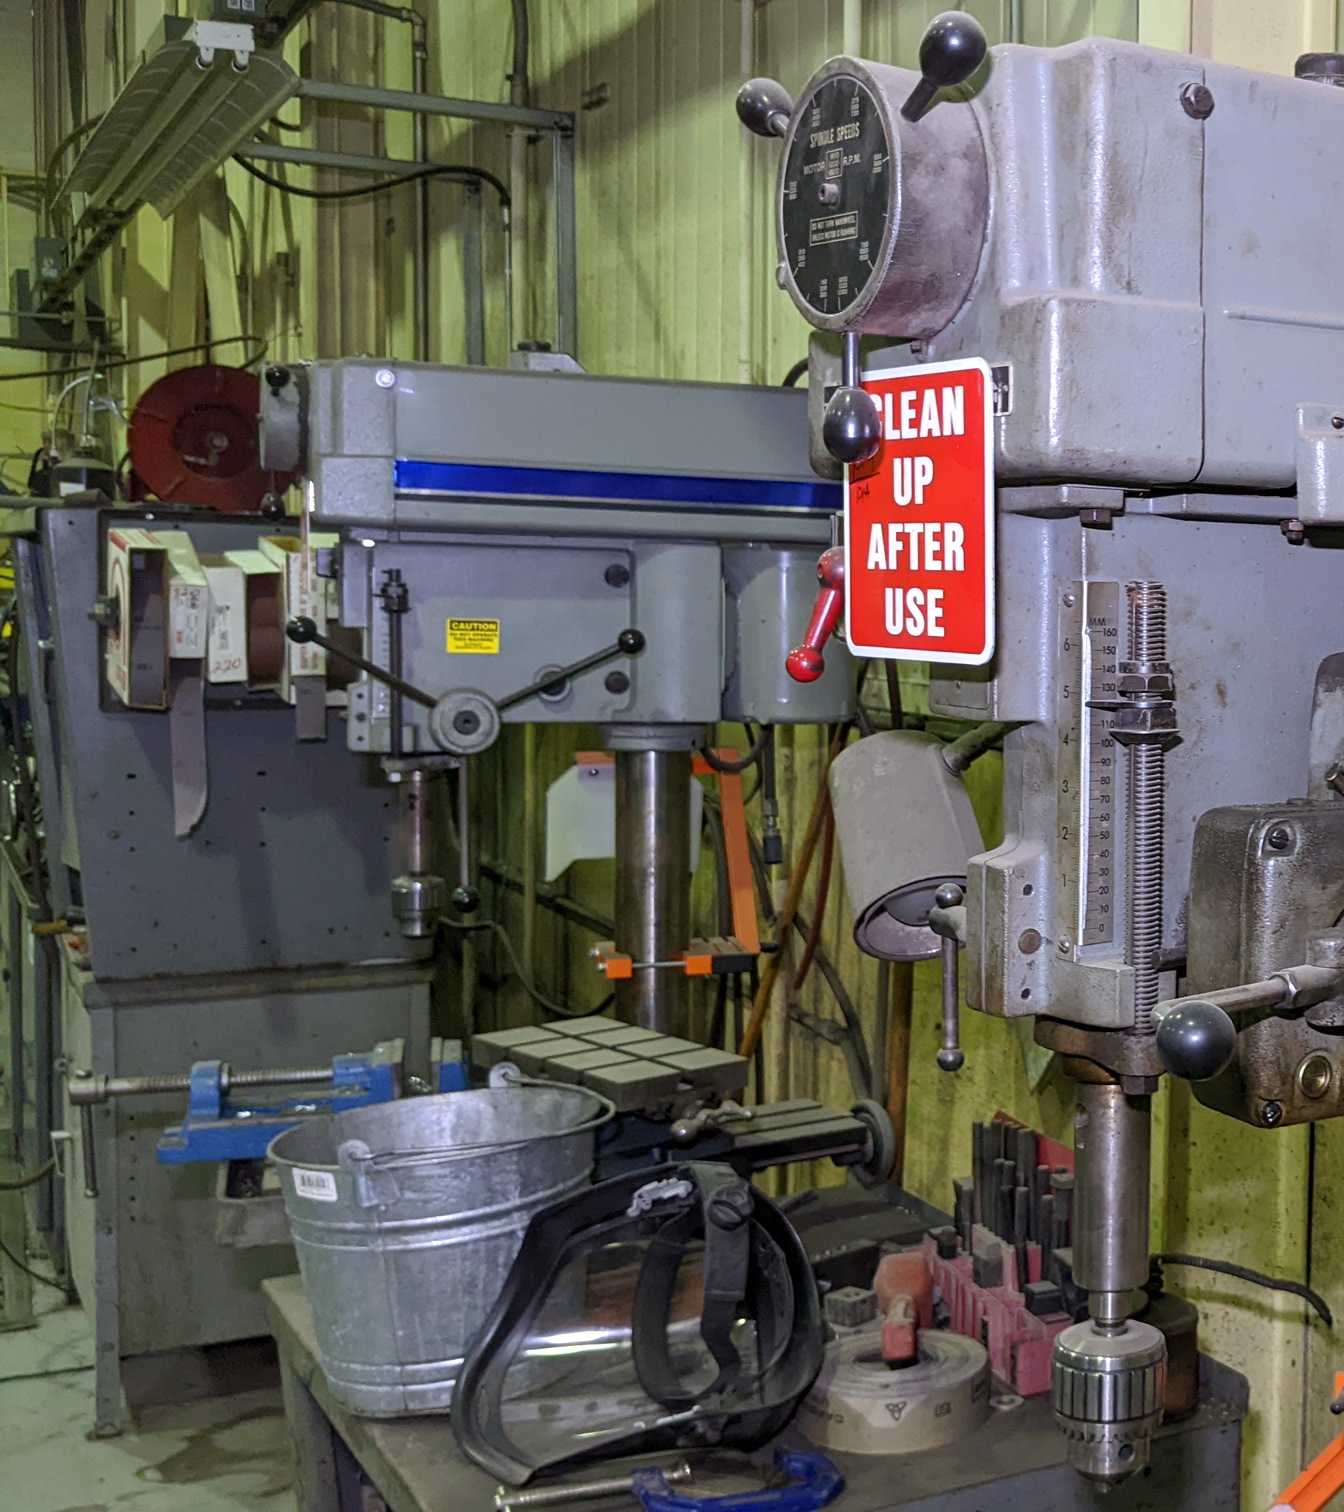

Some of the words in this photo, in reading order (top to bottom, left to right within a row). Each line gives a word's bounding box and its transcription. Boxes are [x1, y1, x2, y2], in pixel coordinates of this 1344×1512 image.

[810, 128, 834, 148] SPINDLE
[836, 121, 860, 142] SPEEDS
[892, 456, 934, 507] UP
[867, 523, 965, 571] AFTER
[885, 588, 945, 637] USE
[451, 622, 497, 631] CAUTION
[1089, 617, 1106, 626] MM
[1103, 628, 1118, 637] 160
[1063, 638, 1071, 652] 6
[1103, 646, 1117, 656] 150
[1102, 664, 1117, 674] 140
[1063, 685, 1071, 699] 5
[1102, 682, 1116, 692] 130
[1101, 719, 1115, 729] 110
[1062, 733, 1069, 746] 4
[1101, 738, 1114, 748] 100
[1100, 758, 1111, 767] 90
[1100, 776, 1111, 785] 80
[1062, 779, 1069, 794] 3
[1100, 795, 1111, 804] 70
[1100, 813, 1111, 822] 60
[1062, 826, 1069, 840] 2
[1100, 831, 1110, 840] 50
[1100, 849, 1110, 858] 40
[1099, 867, 1110, 877] 30
[1062, 873, 1067, 888] 1
[1099, 886, 1110, 895] 20
[1099, 904, 1110, 913] 10
[1098, 924, 1105, 933] 0
